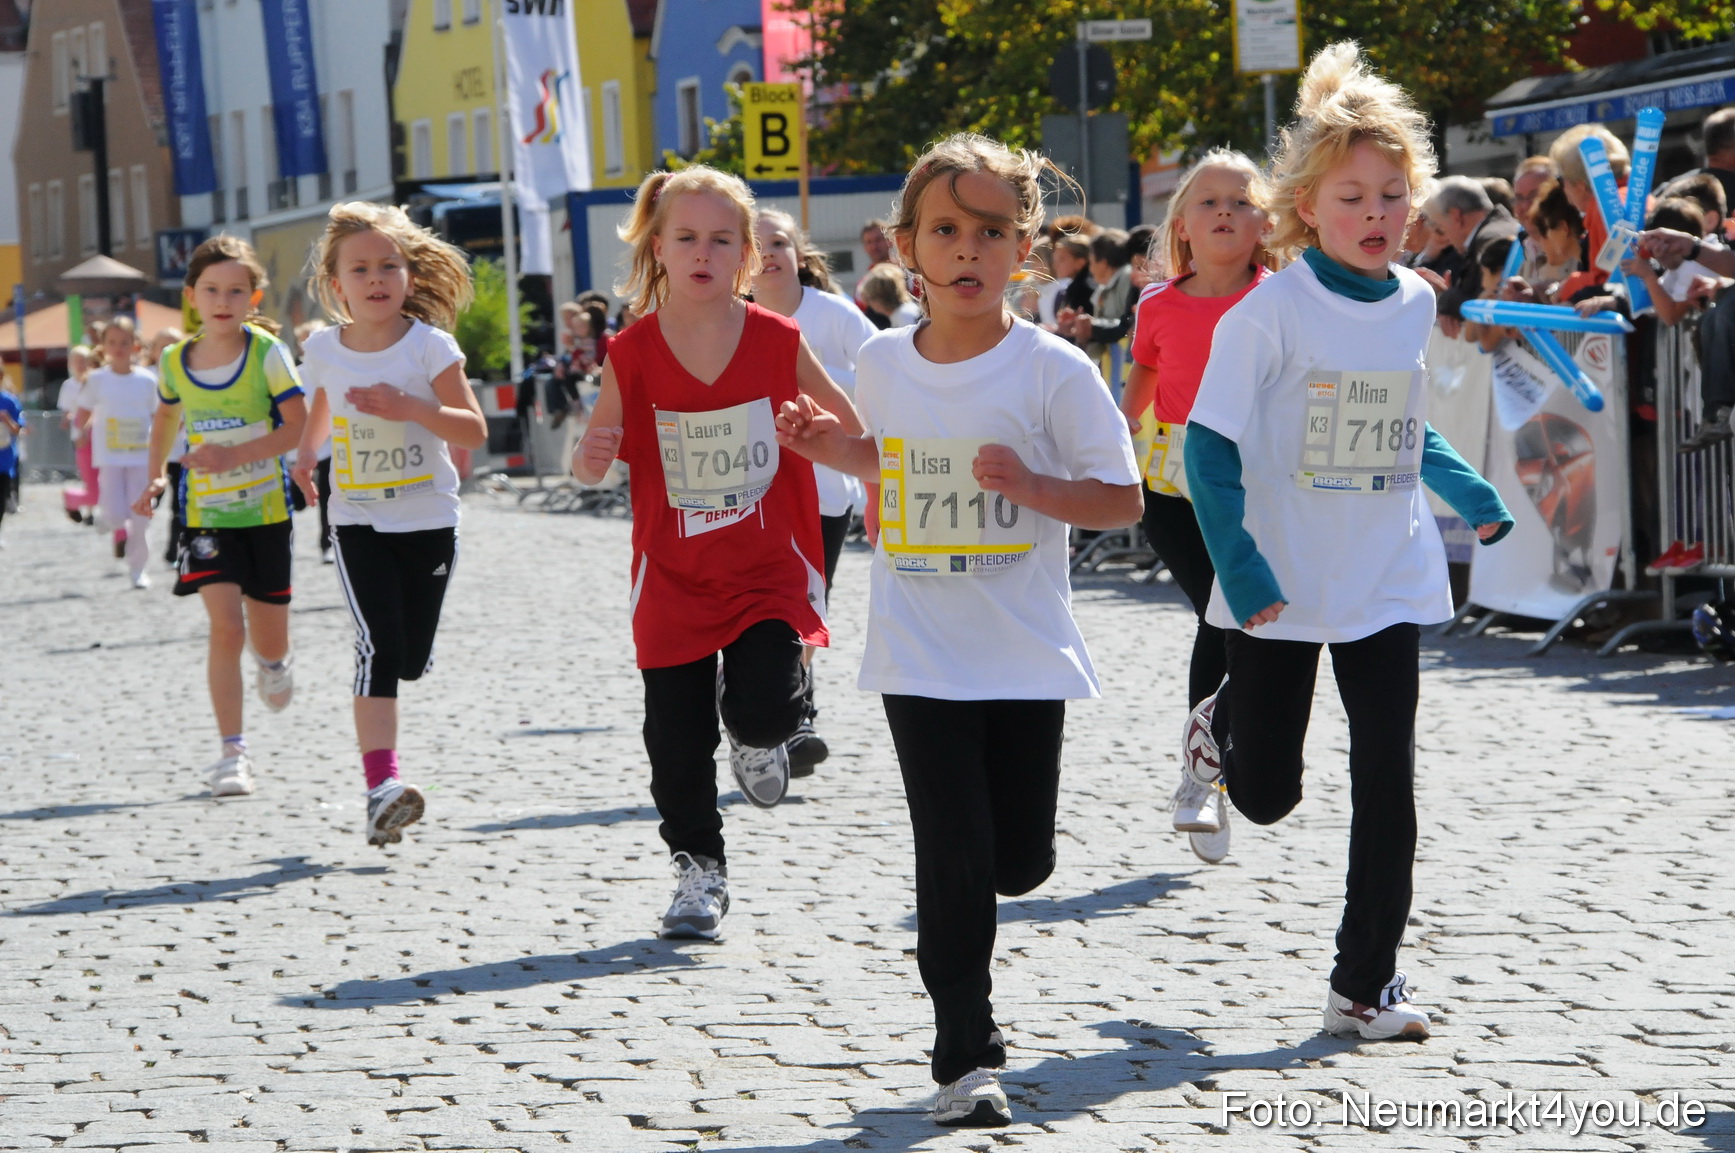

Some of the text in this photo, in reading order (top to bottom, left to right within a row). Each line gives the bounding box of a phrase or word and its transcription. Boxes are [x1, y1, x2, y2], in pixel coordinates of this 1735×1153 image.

[751, 85, 797, 104] Block
[760, 112, 791, 157] B
[1630, 156, 1651, 226] axi-dsl.de
[1346, 380, 1388, 404] Alina
[191, 417, 246, 432] BOCK
[351, 423, 376, 440] Eva
[684, 419, 733, 440] Laura
[1309, 416, 1329, 434] K3
[1346, 417, 1418, 452] 7188
[356, 443, 424, 474] 7203
[663, 447, 679, 463] K3
[690, 440, 770, 478] 7040
[909, 449, 952, 476] Lisa
[883, 489, 898, 509] K3
[704, 507, 739, 524] DEHN
[914, 491, 1020, 529] 7110
[894, 556, 928, 569] BOCK
